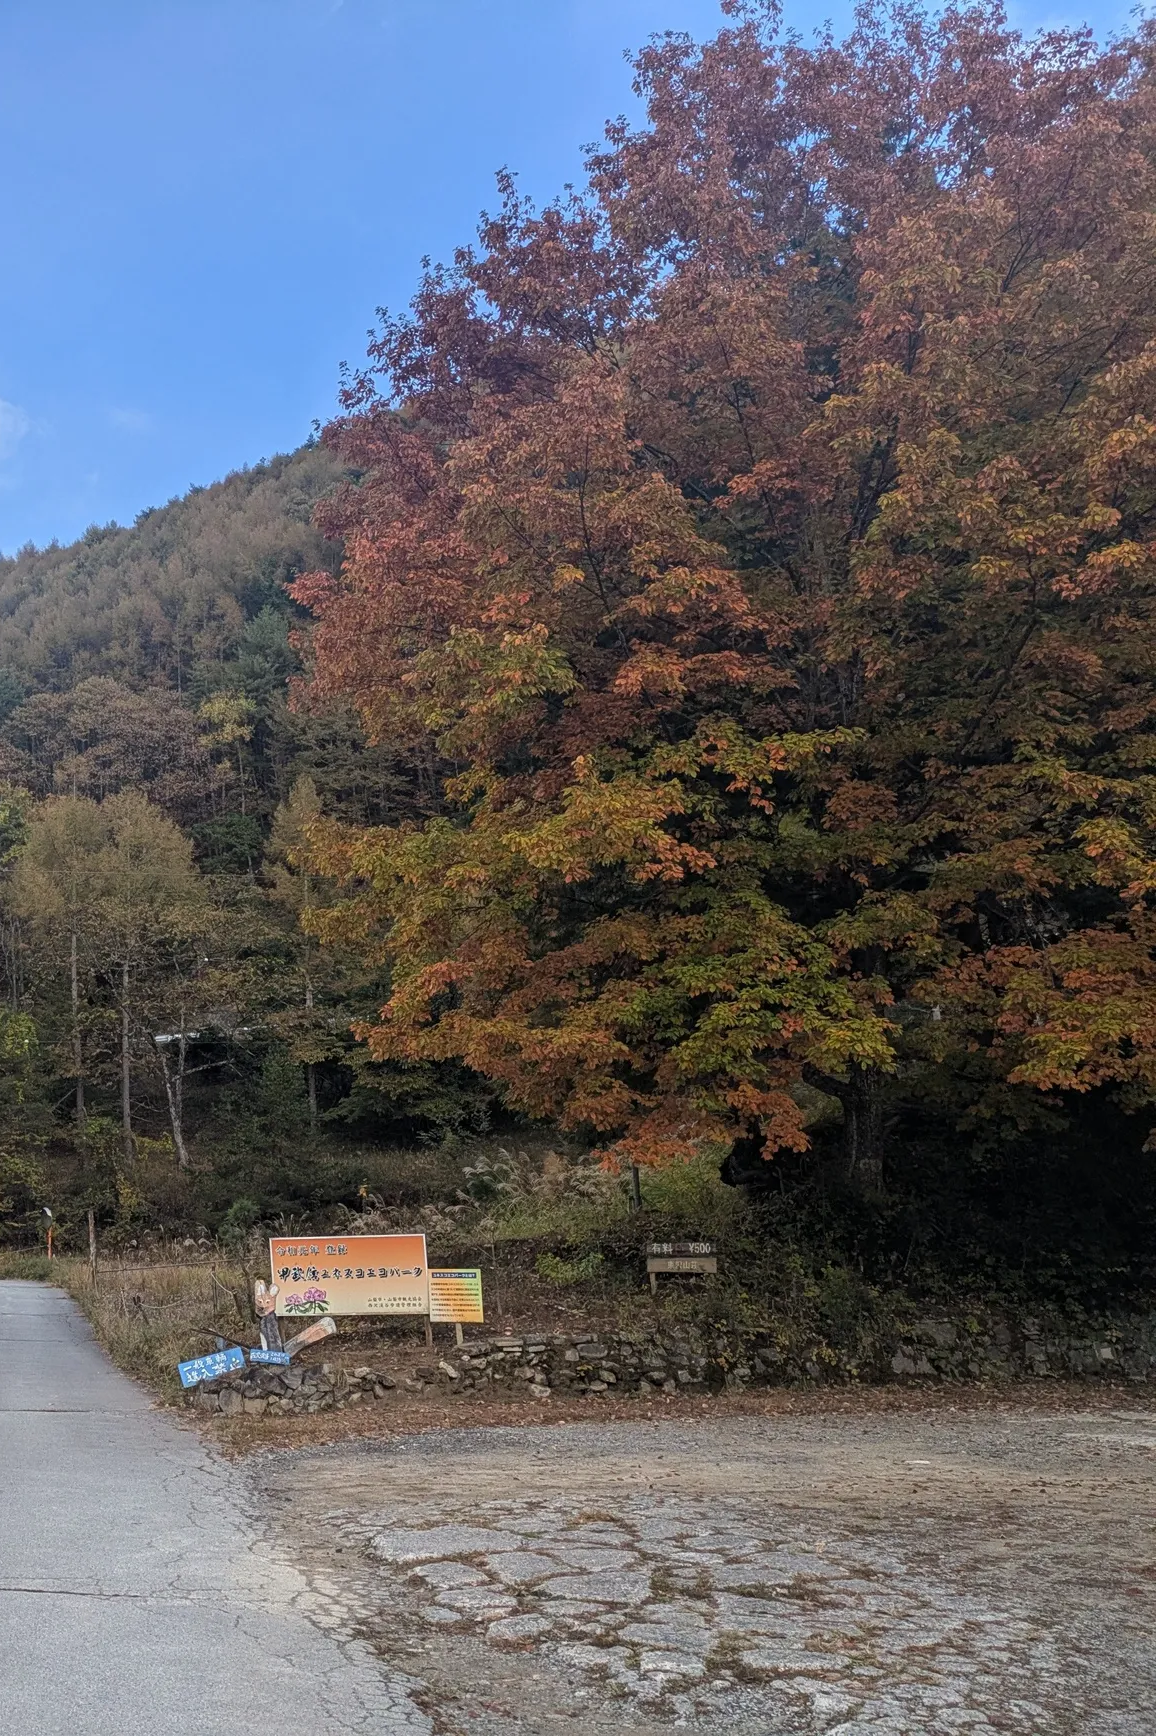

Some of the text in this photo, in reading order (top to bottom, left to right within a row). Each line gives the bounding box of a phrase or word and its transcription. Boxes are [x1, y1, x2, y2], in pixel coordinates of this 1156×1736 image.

[651, 1242, 711, 1255] 有料 ¥500
[186, 1357, 244, 1383] 進入禁止
